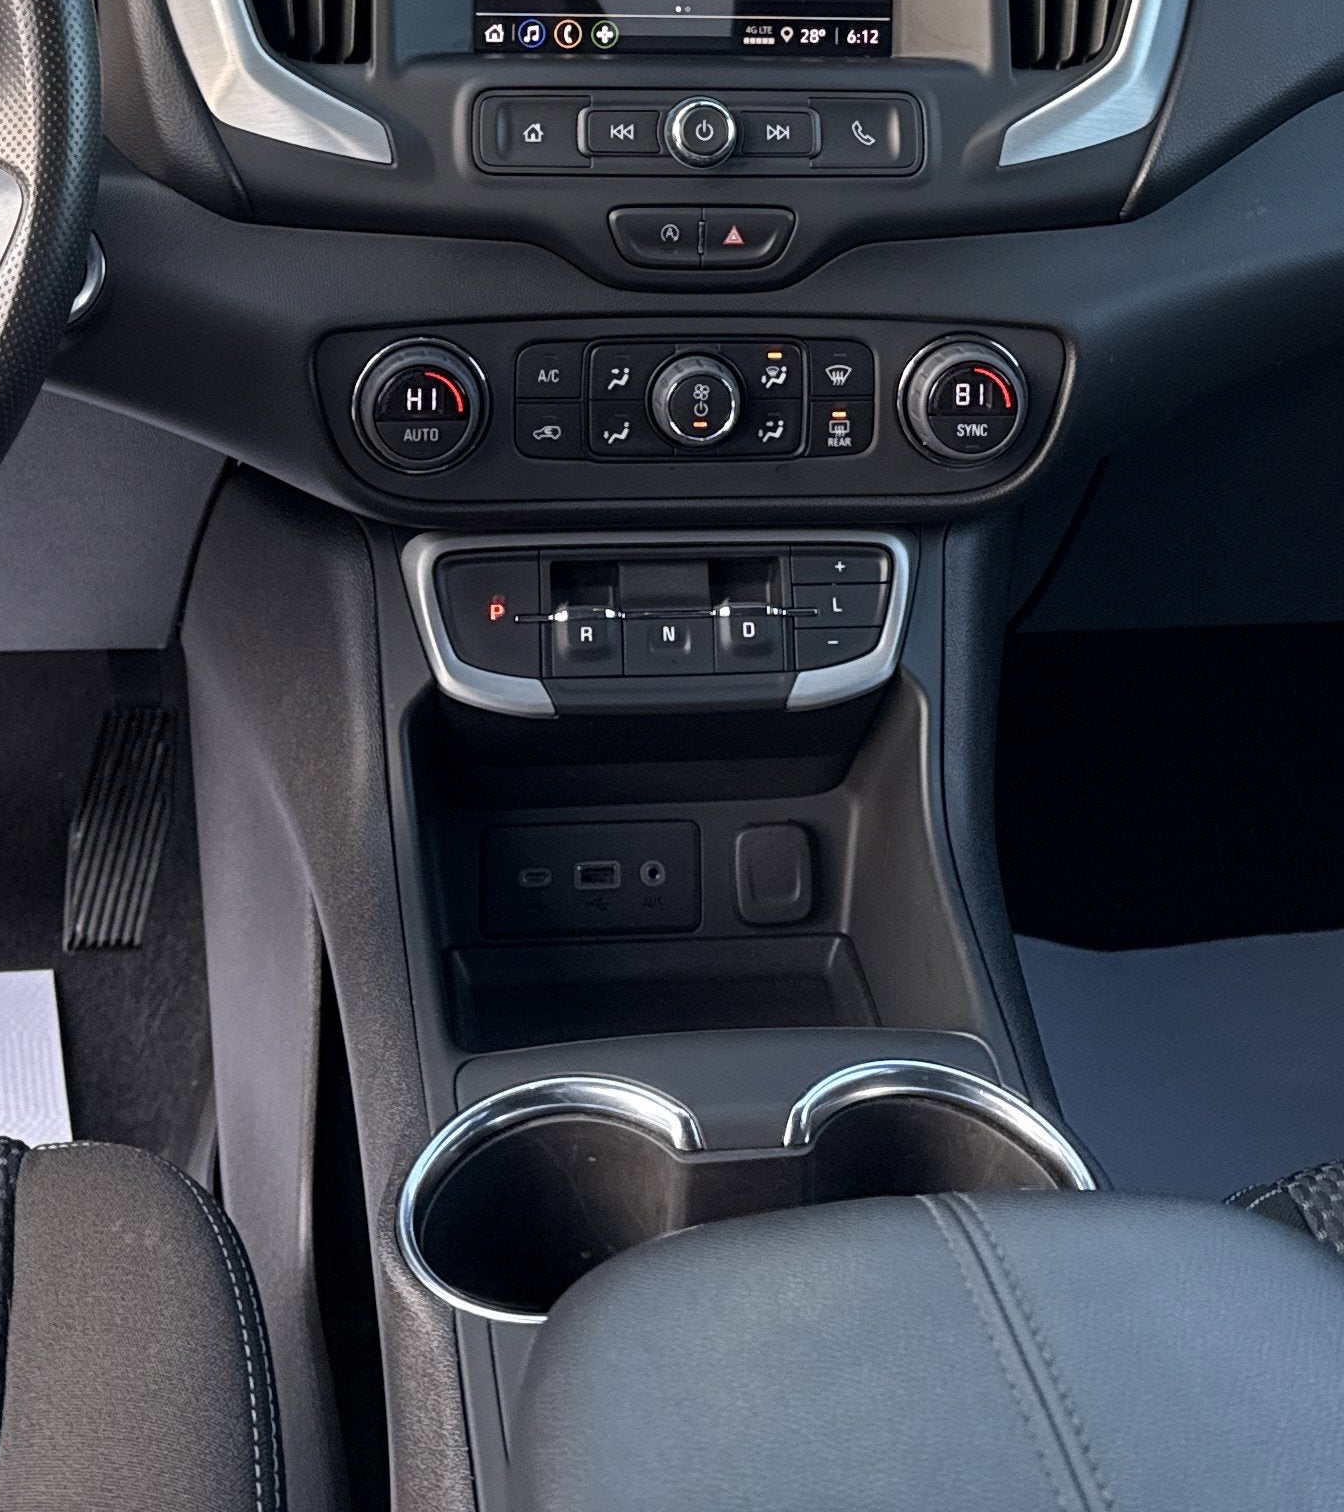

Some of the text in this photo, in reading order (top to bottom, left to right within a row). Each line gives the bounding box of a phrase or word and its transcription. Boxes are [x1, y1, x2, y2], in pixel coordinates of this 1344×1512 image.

[745, 25, 773, 35] 4G LTE
[846, 29, 879, 45] 6:12
[537, 369, 560, 383] A/C
[404, 427, 439, 442] AUTO
[956, 423, 988, 438] SYNC
[827, 437, 853, 448] REAR
[490, 604, 506, 621] P
[832, 597, 843, 613] L
[580, 626, 593, 642] R
[662, 625, 675, 642] N
[742, 621, 755, 638] D
